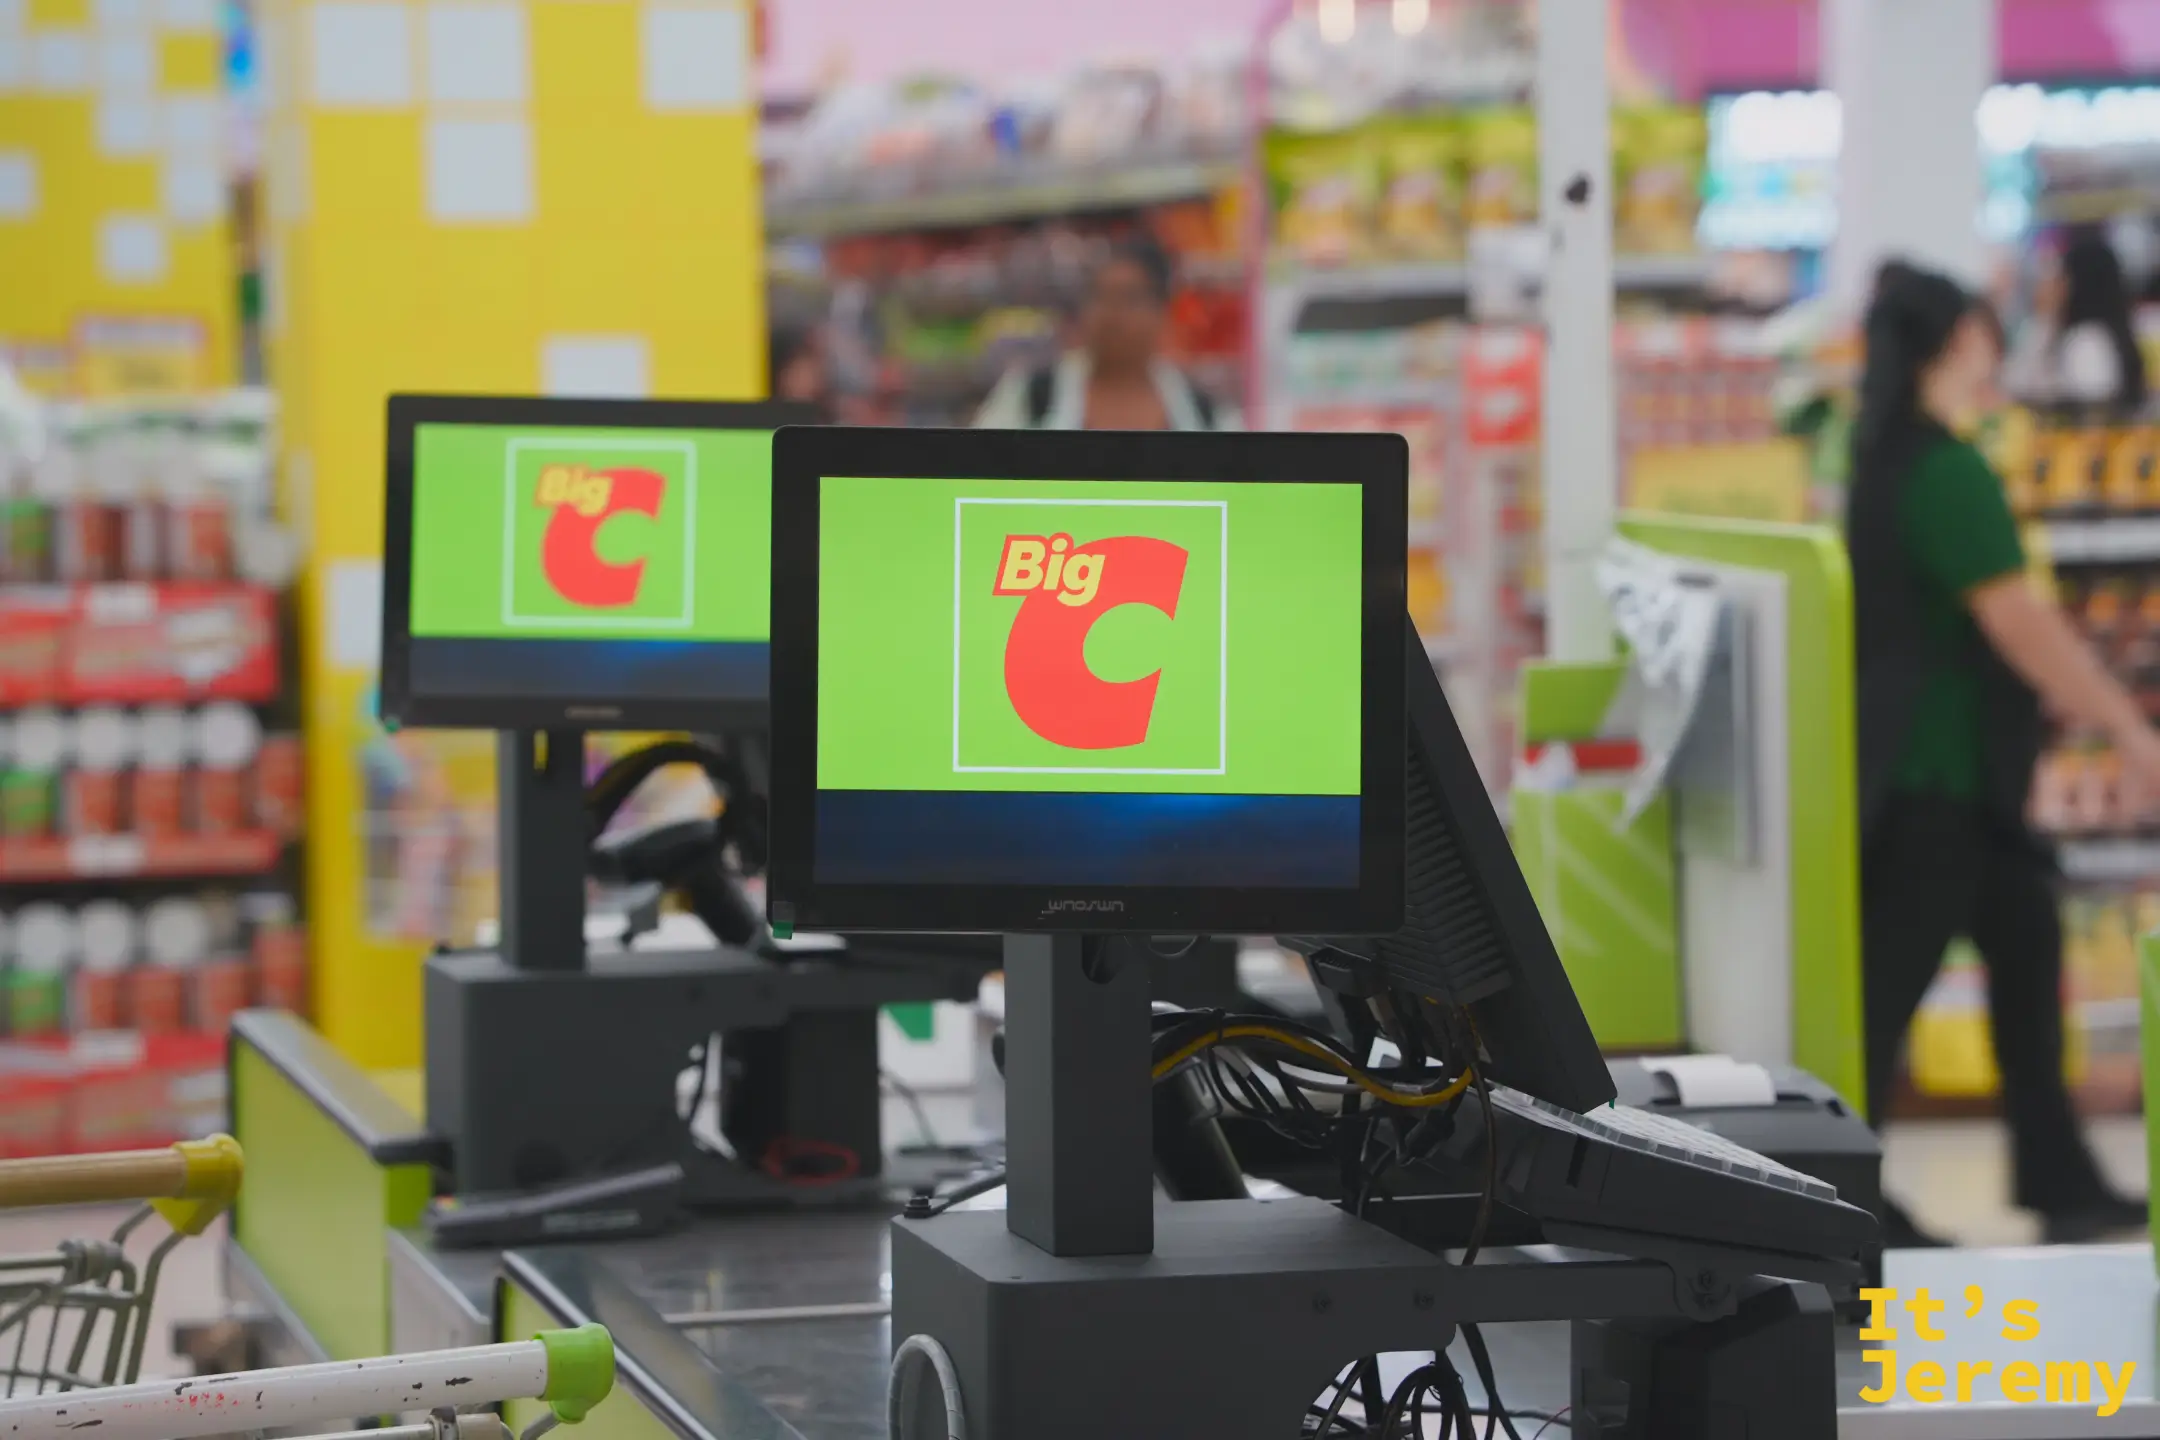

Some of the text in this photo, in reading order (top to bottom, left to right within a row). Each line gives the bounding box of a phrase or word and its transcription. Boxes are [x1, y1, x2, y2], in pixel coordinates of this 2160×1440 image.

[538, 466, 614, 518] Big
[541, 467, 666, 608] C
[1000, 537, 1106, 607] Big
[1004, 535, 1189, 750] C
